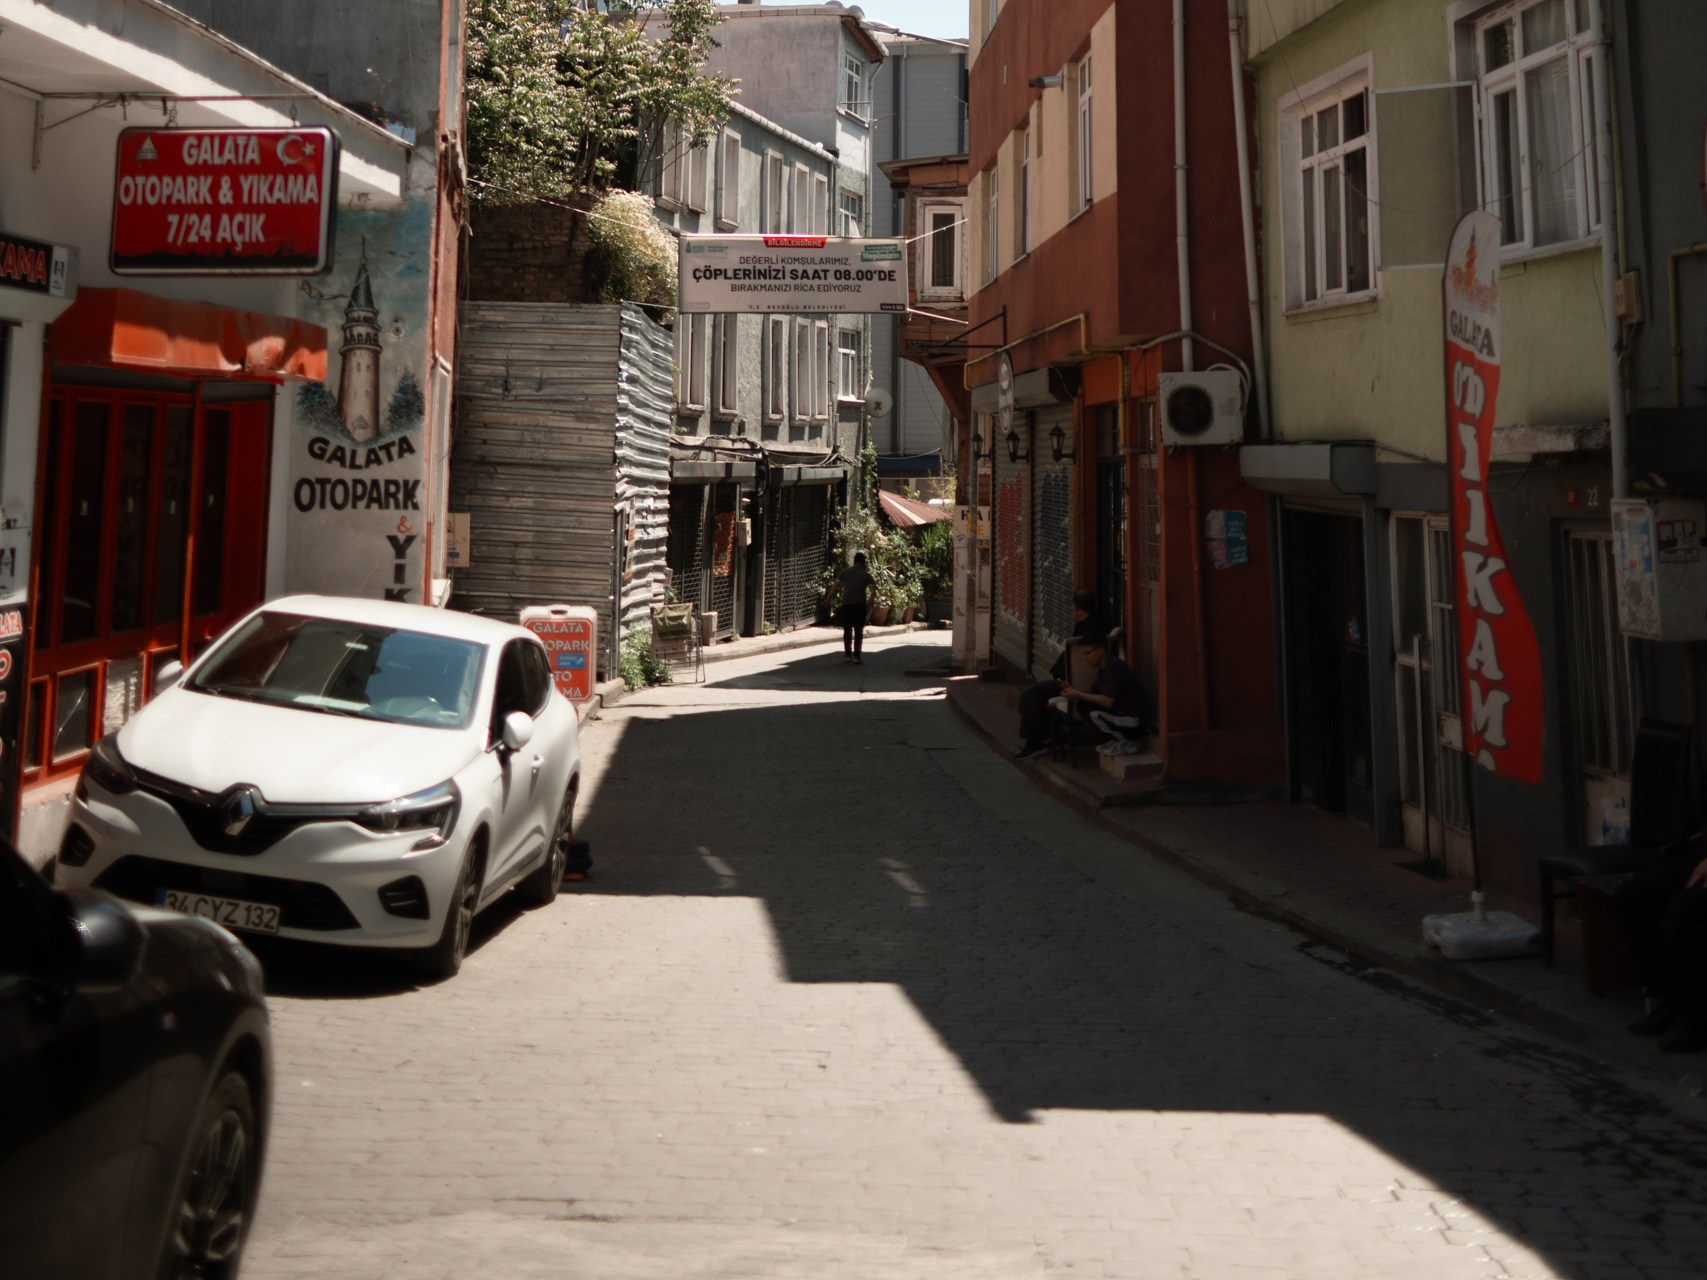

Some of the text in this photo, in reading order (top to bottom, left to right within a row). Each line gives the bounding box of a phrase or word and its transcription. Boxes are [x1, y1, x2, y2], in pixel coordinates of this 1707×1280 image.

[181, 135, 261, 166] GALATA
[119, 174, 319, 206] OTOPARK & YIKAMA
[165, 212, 267, 252] 7/24 AÇIK
[739, 255, 779, 265] DEĞERLİ
[692, 265, 786, 283] ÇÖPLERİNİZİ
[790, 269, 830, 281] SAAT
[730, 283, 862, 293] BIRAKMANIZI RİCA EDİYORUZ
[308, 436, 416, 470] GALATA
[294, 477, 422, 513] OTOPARK
[396, 515, 413, 534] &
[532, 623, 585, 634] GALATA
[542, 640, 591, 651] OPARK
[553, 671, 573, 682] TO
[167, 892, 188, 913] 34
[244, 904, 278, 931] 132
